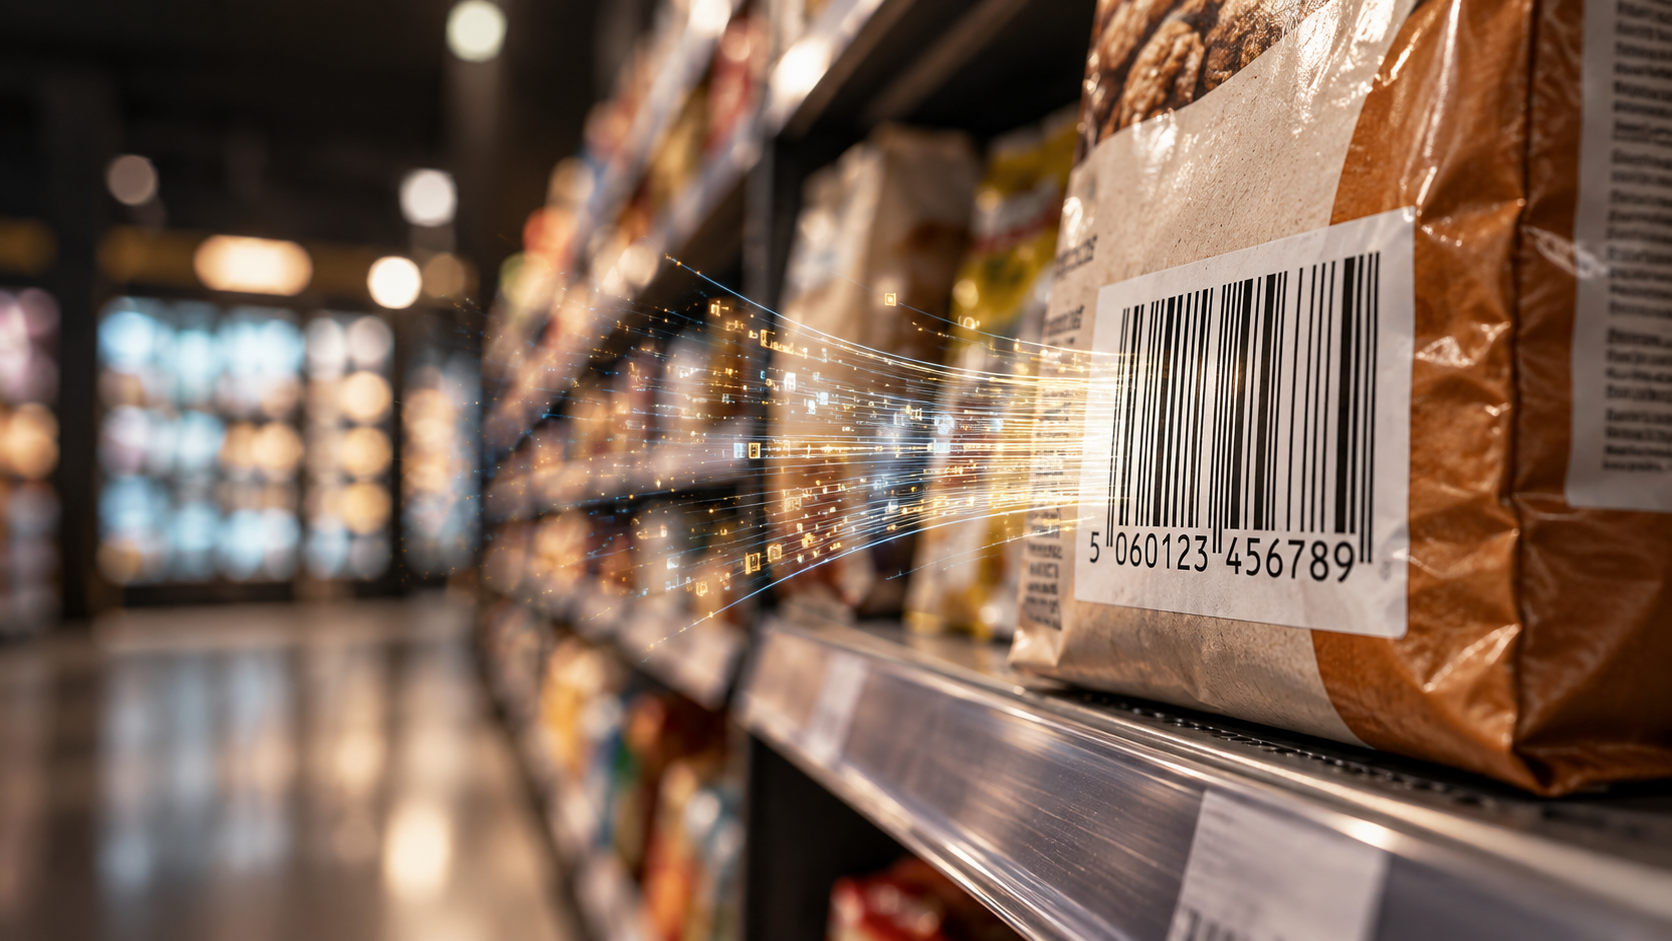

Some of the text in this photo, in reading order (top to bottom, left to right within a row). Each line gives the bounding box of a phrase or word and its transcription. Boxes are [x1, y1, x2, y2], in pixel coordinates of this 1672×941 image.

[1090, 532, 1355, 583] 5 060123 456789
